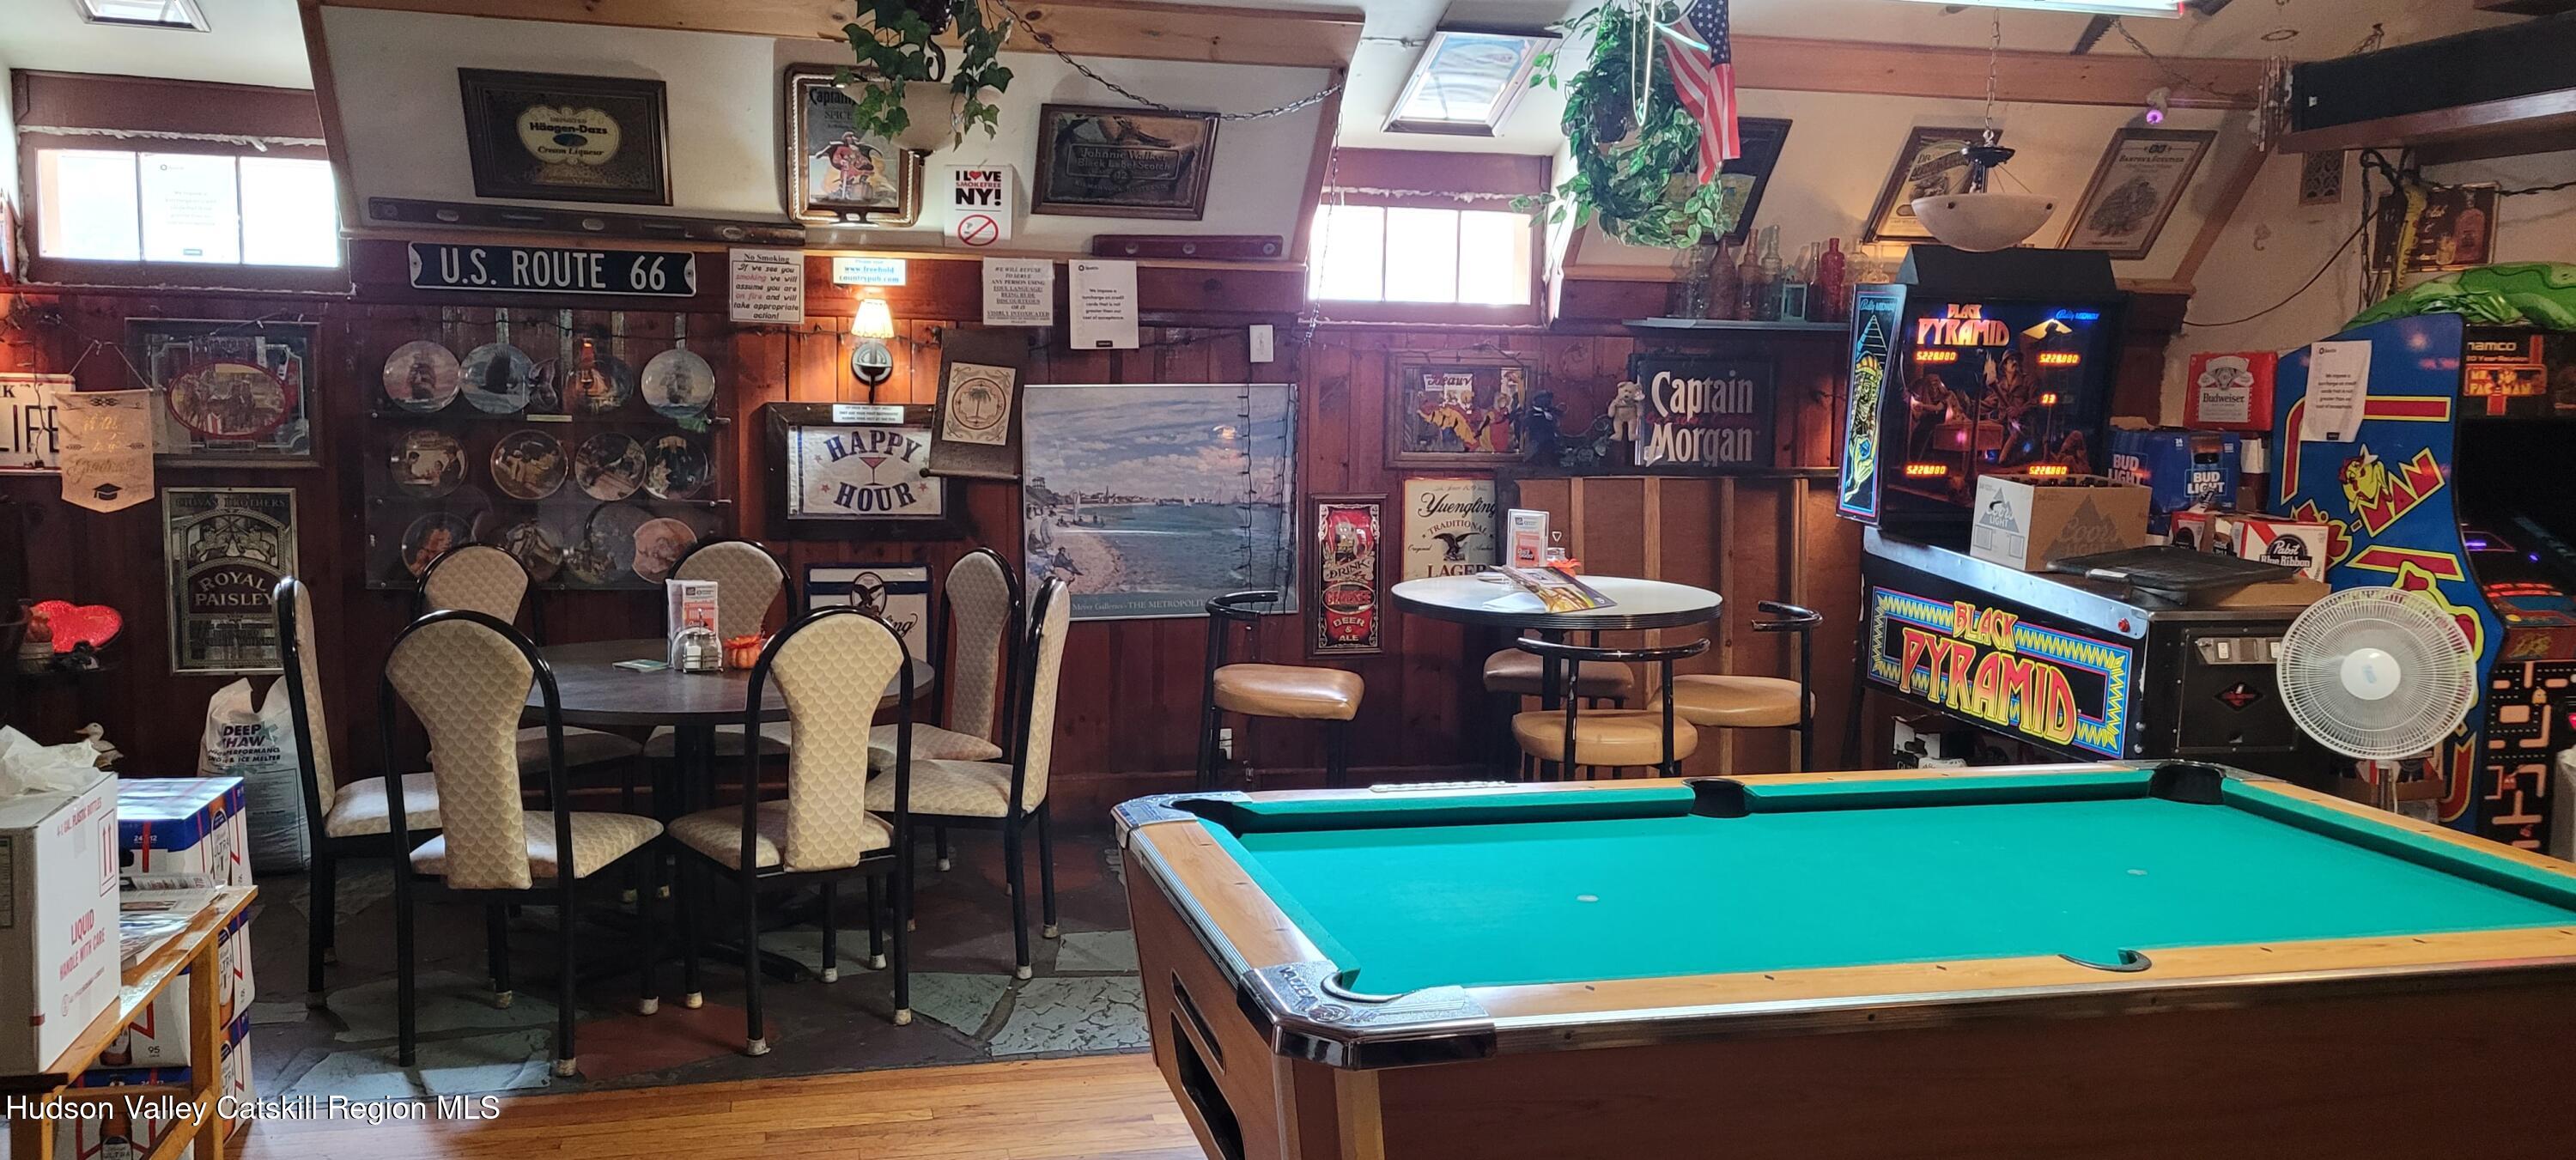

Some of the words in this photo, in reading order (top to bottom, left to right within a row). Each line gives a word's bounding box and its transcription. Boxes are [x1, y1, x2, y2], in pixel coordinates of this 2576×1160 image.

[824, 110, 853, 119] SPICE
[530, 122, 608, 134] Häagen-Dazs
[568, 147, 605, 156] Liqueur
[1081, 148, 1127, 160] Johnnie
[1128, 149, 1168, 161] Walker
[1078, 158, 1107, 168] Black
[1109, 160, 1136, 168] Label
[1139, 161, 1170, 171] Scotch
[956, 170, 960, 181] I
[956, 187, 1001, 206] NY!
[756, 254, 790, 263] Smoking
[440, 246, 497, 286] U.S.
[512, 250, 606, 288] ROUTE
[630, 255, 665, 291] 66
[735, 274, 767, 282] smoking
[1917, 318, 2010, 347] PYRAMID
[2467, 341, 2517, 351] namco
[1651, 369, 1753, 422] Captain
[2202, 392, 2245, 403] Budweiser
[0, 404, 60, 453] IFE
[823, 429, 922, 463] HAPPY
[1645, 422, 1753, 468] Morgan
[2112, 453, 2140, 471] BUD
[2107, 468, 2145, 485] LIGHT
[2193, 471, 2221, 483] BUD
[2187, 482, 2226, 495] LIGHT
[224, 496, 286, 507] BROTHERS
[833, 482, 917, 512] HOUR
[1418, 492, 1497, 519] Yuengling
[1985, 500, 2014, 521] Coors
[1427, 519, 1487, 536] TRADITIONAL
[1989, 516, 2010, 527] LIGHT
[2060, 516, 2119, 544] Coors
[2273, 539, 2300, 555] Pabst
[1328, 560, 1366, 580] DRINK
[2281, 556, 2311, 568] Ribbon
[1427, 564, 1487, 578] LAGER
[198, 571, 268, 592] ROYAL
[196, 592, 275, 606] PAISLEY
[1148, 598, 1208, 609] METROPOLIT
[1333, 616, 1365, 628] BEER
[1953, 601, 2018, 652] BLACK
[1899, 627, 2077, 745] PYRAMID
[223, 724, 262, 737] DEEP
[70, 908, 94, 945] LIQUID
[59, 950, 78, 981] HANDLE
[79, 939, 92, 962] WITH
[92, 927, 105, 950] CARE
